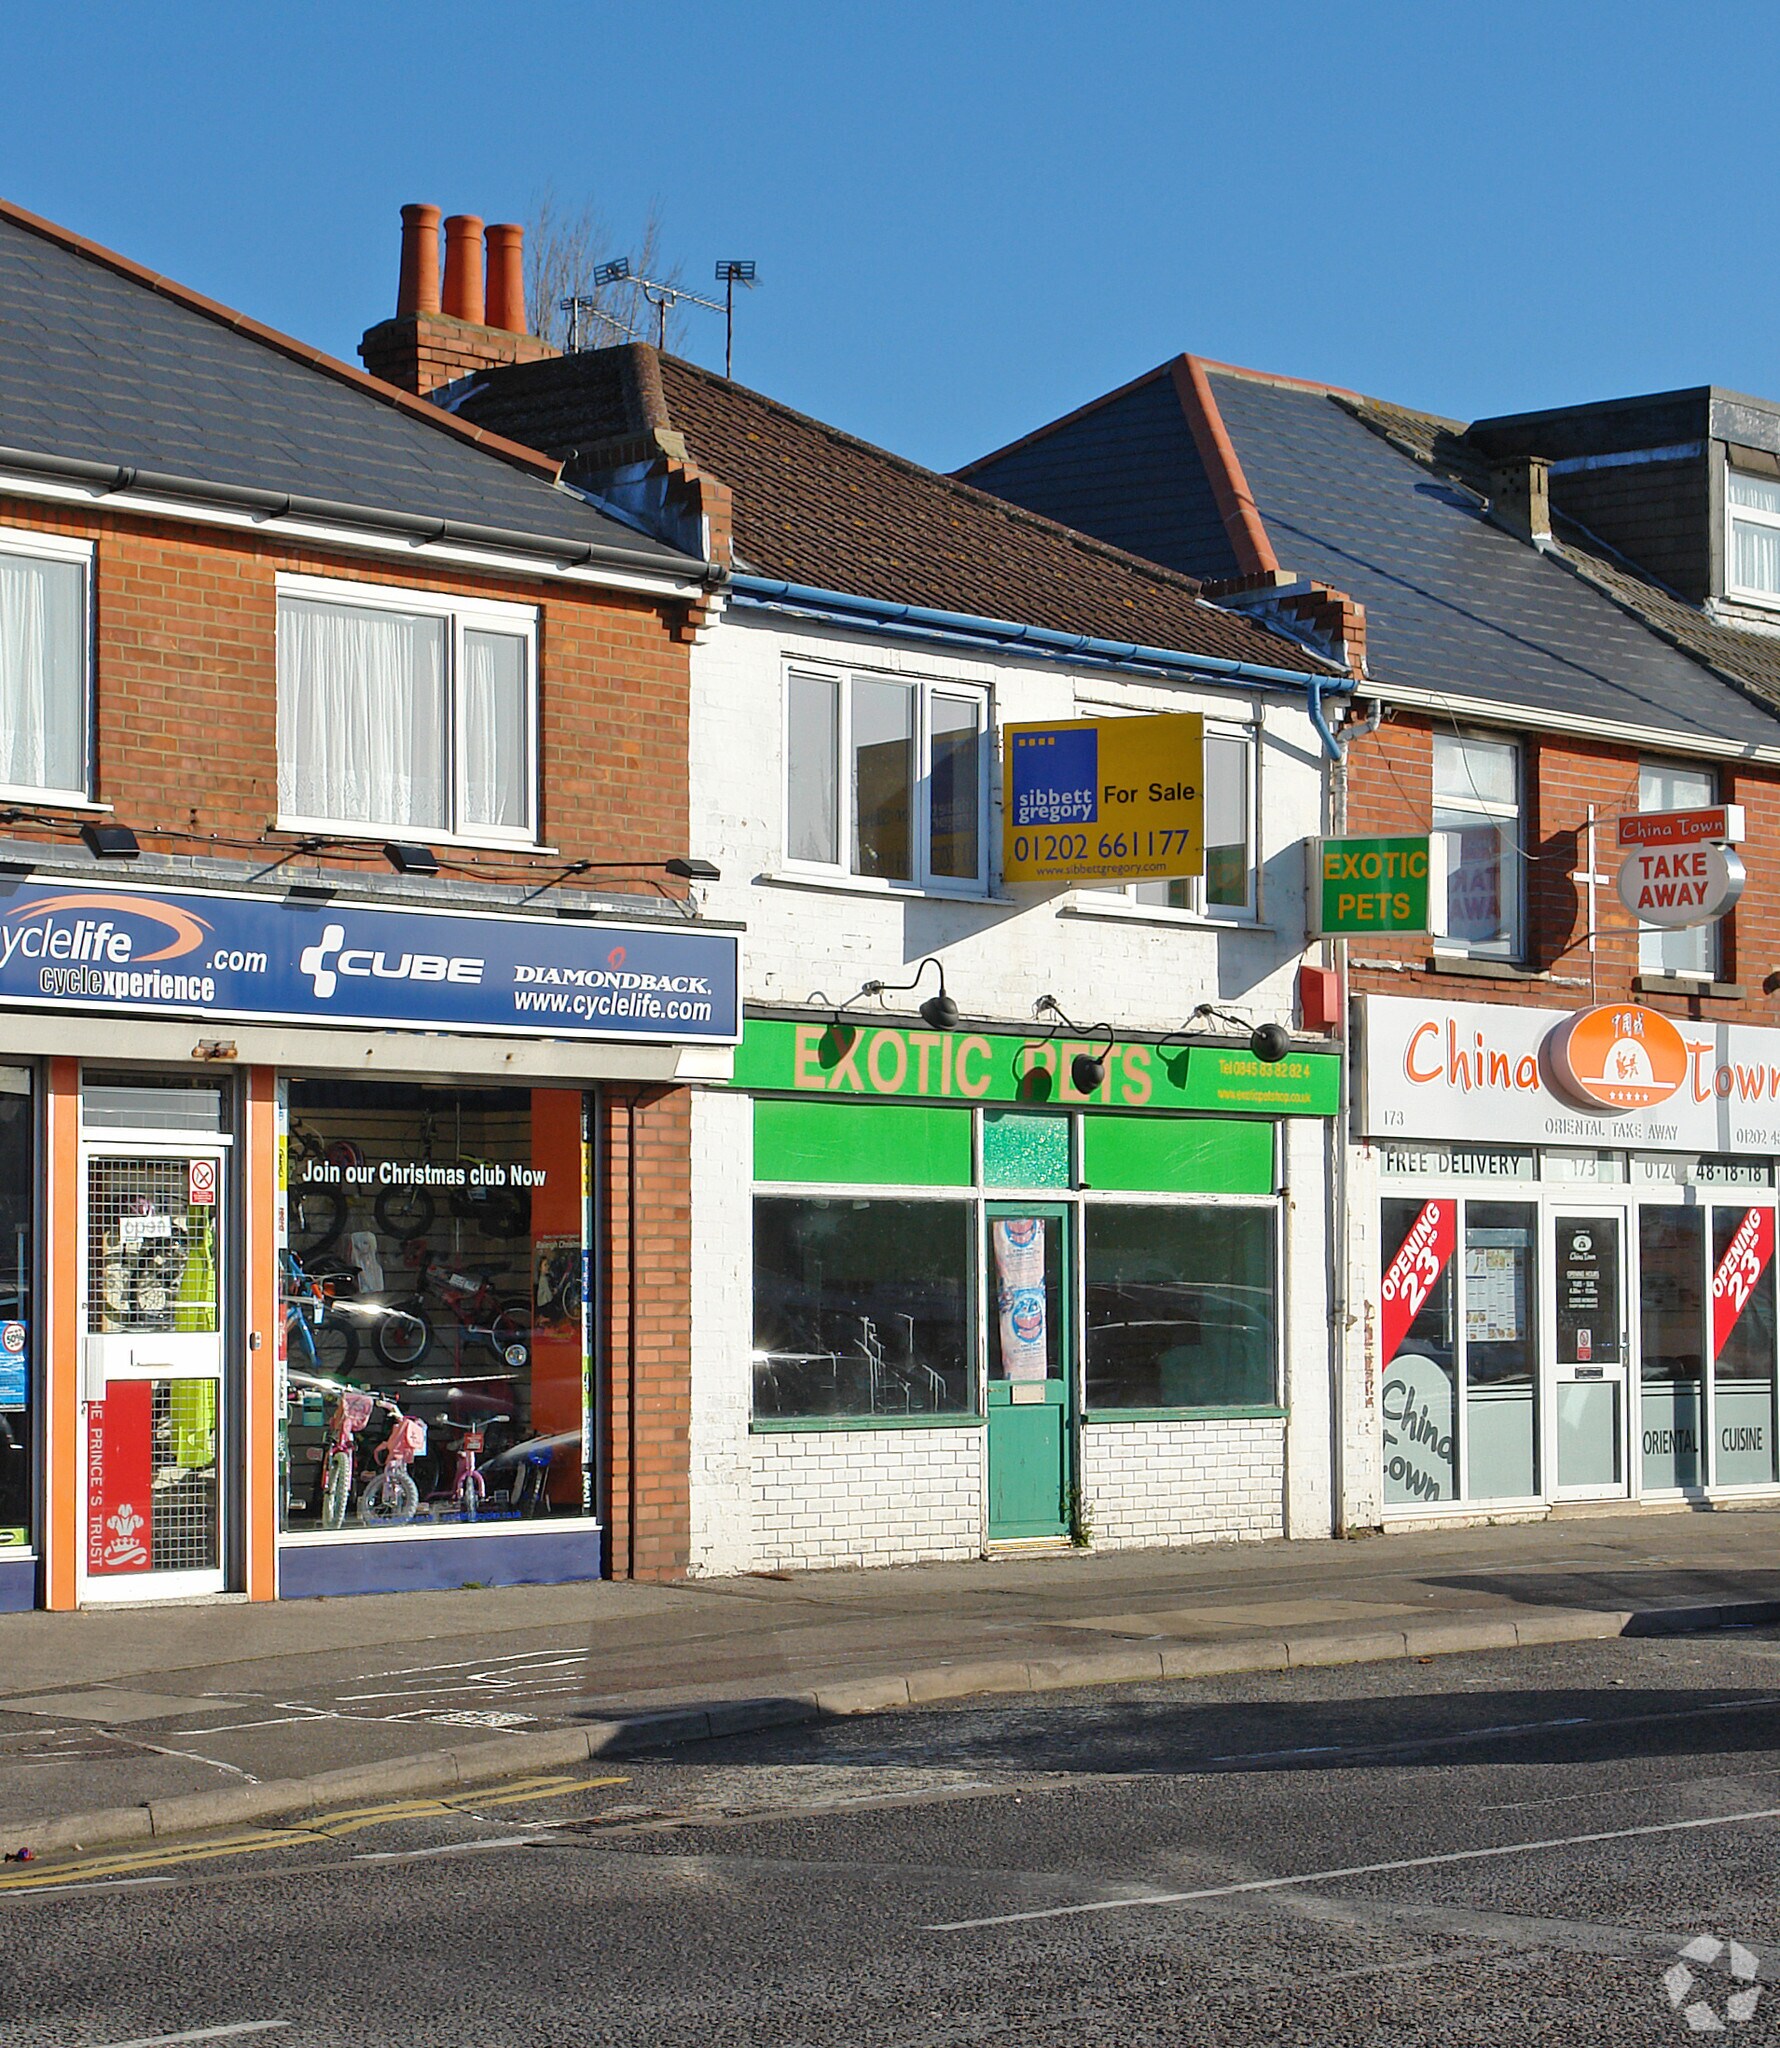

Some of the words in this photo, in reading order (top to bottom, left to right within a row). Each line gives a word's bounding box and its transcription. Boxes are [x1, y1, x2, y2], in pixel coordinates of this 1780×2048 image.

[1019, 788, 1092, 807] sibbett
[1104, 786, 1138, 804] For
[1148, 782, 1195, 802] Sale
[1019, 803, 1092, 824] gregory
[1622, 821, 1672, 839] China
[1677, 818, 1723, 836] Town
[1014, 834, 1088, 862] 01202
[1098, 829, 1189, 859] 661177
[1036, 862, 1166, 876] www.sibbettgregory.com
[1323, 850, 1427, 879] EXOTIC
[1638, 852, 1707, 879] TAKE
[1338, 893, 1410, 920] PETS
[1638, 881, 1708, 909] AWAY
[0, 918, 133, 969] yclelife
[206, 949, 268, 973] .com
[337, 950, 486, 984] CUBE
[39, 964, 216, 1002] cyclexperience
[513, 990, 712, 1021] www.cyclelife.com
[793, 1025, 993, 1098] EXOTIC
[1021, 1038, 1152, 1106] PETS
[1405, 1018, 1540, 1092] China
[1384, 1110, 1404, 1126] 173
[1545, 1117, 1606, 1137] ORIENTAL
[1612, 1122, 1643, 1140] TAKE
[1647, 1124, 1679, 1141] AWAY
[1736, 1127, 1768, 1145] 01202
[302, 1160, 340, 1183] Join
[345, 1165, 375, 1184] our
[378, 1161, 464, 1186] Christmas
[469, 1164, 506, 1186] club
[509, 1164, 547, 1187] Now
[1386, 1151, 1428, 1172] FREE
[1438, 1153, 1520, 1176] DELIVERY
[125, 1220, 167, 1241] open
[1381, 1202, 1440, 1301] OPENING
[1713, 1208, 1762, 1298] OPENING
[1400, 1246, 1440, 1317] 23
[1727, 1248, 1761, 1313] 23
[1382, 1379, 1454, 1465] China
[1642, 1429, 1699, 1455] ORIENTAL
[1722, 1427, 1763, 1452] CUISINE
[90, 1514, 103, 1568] TRUST
